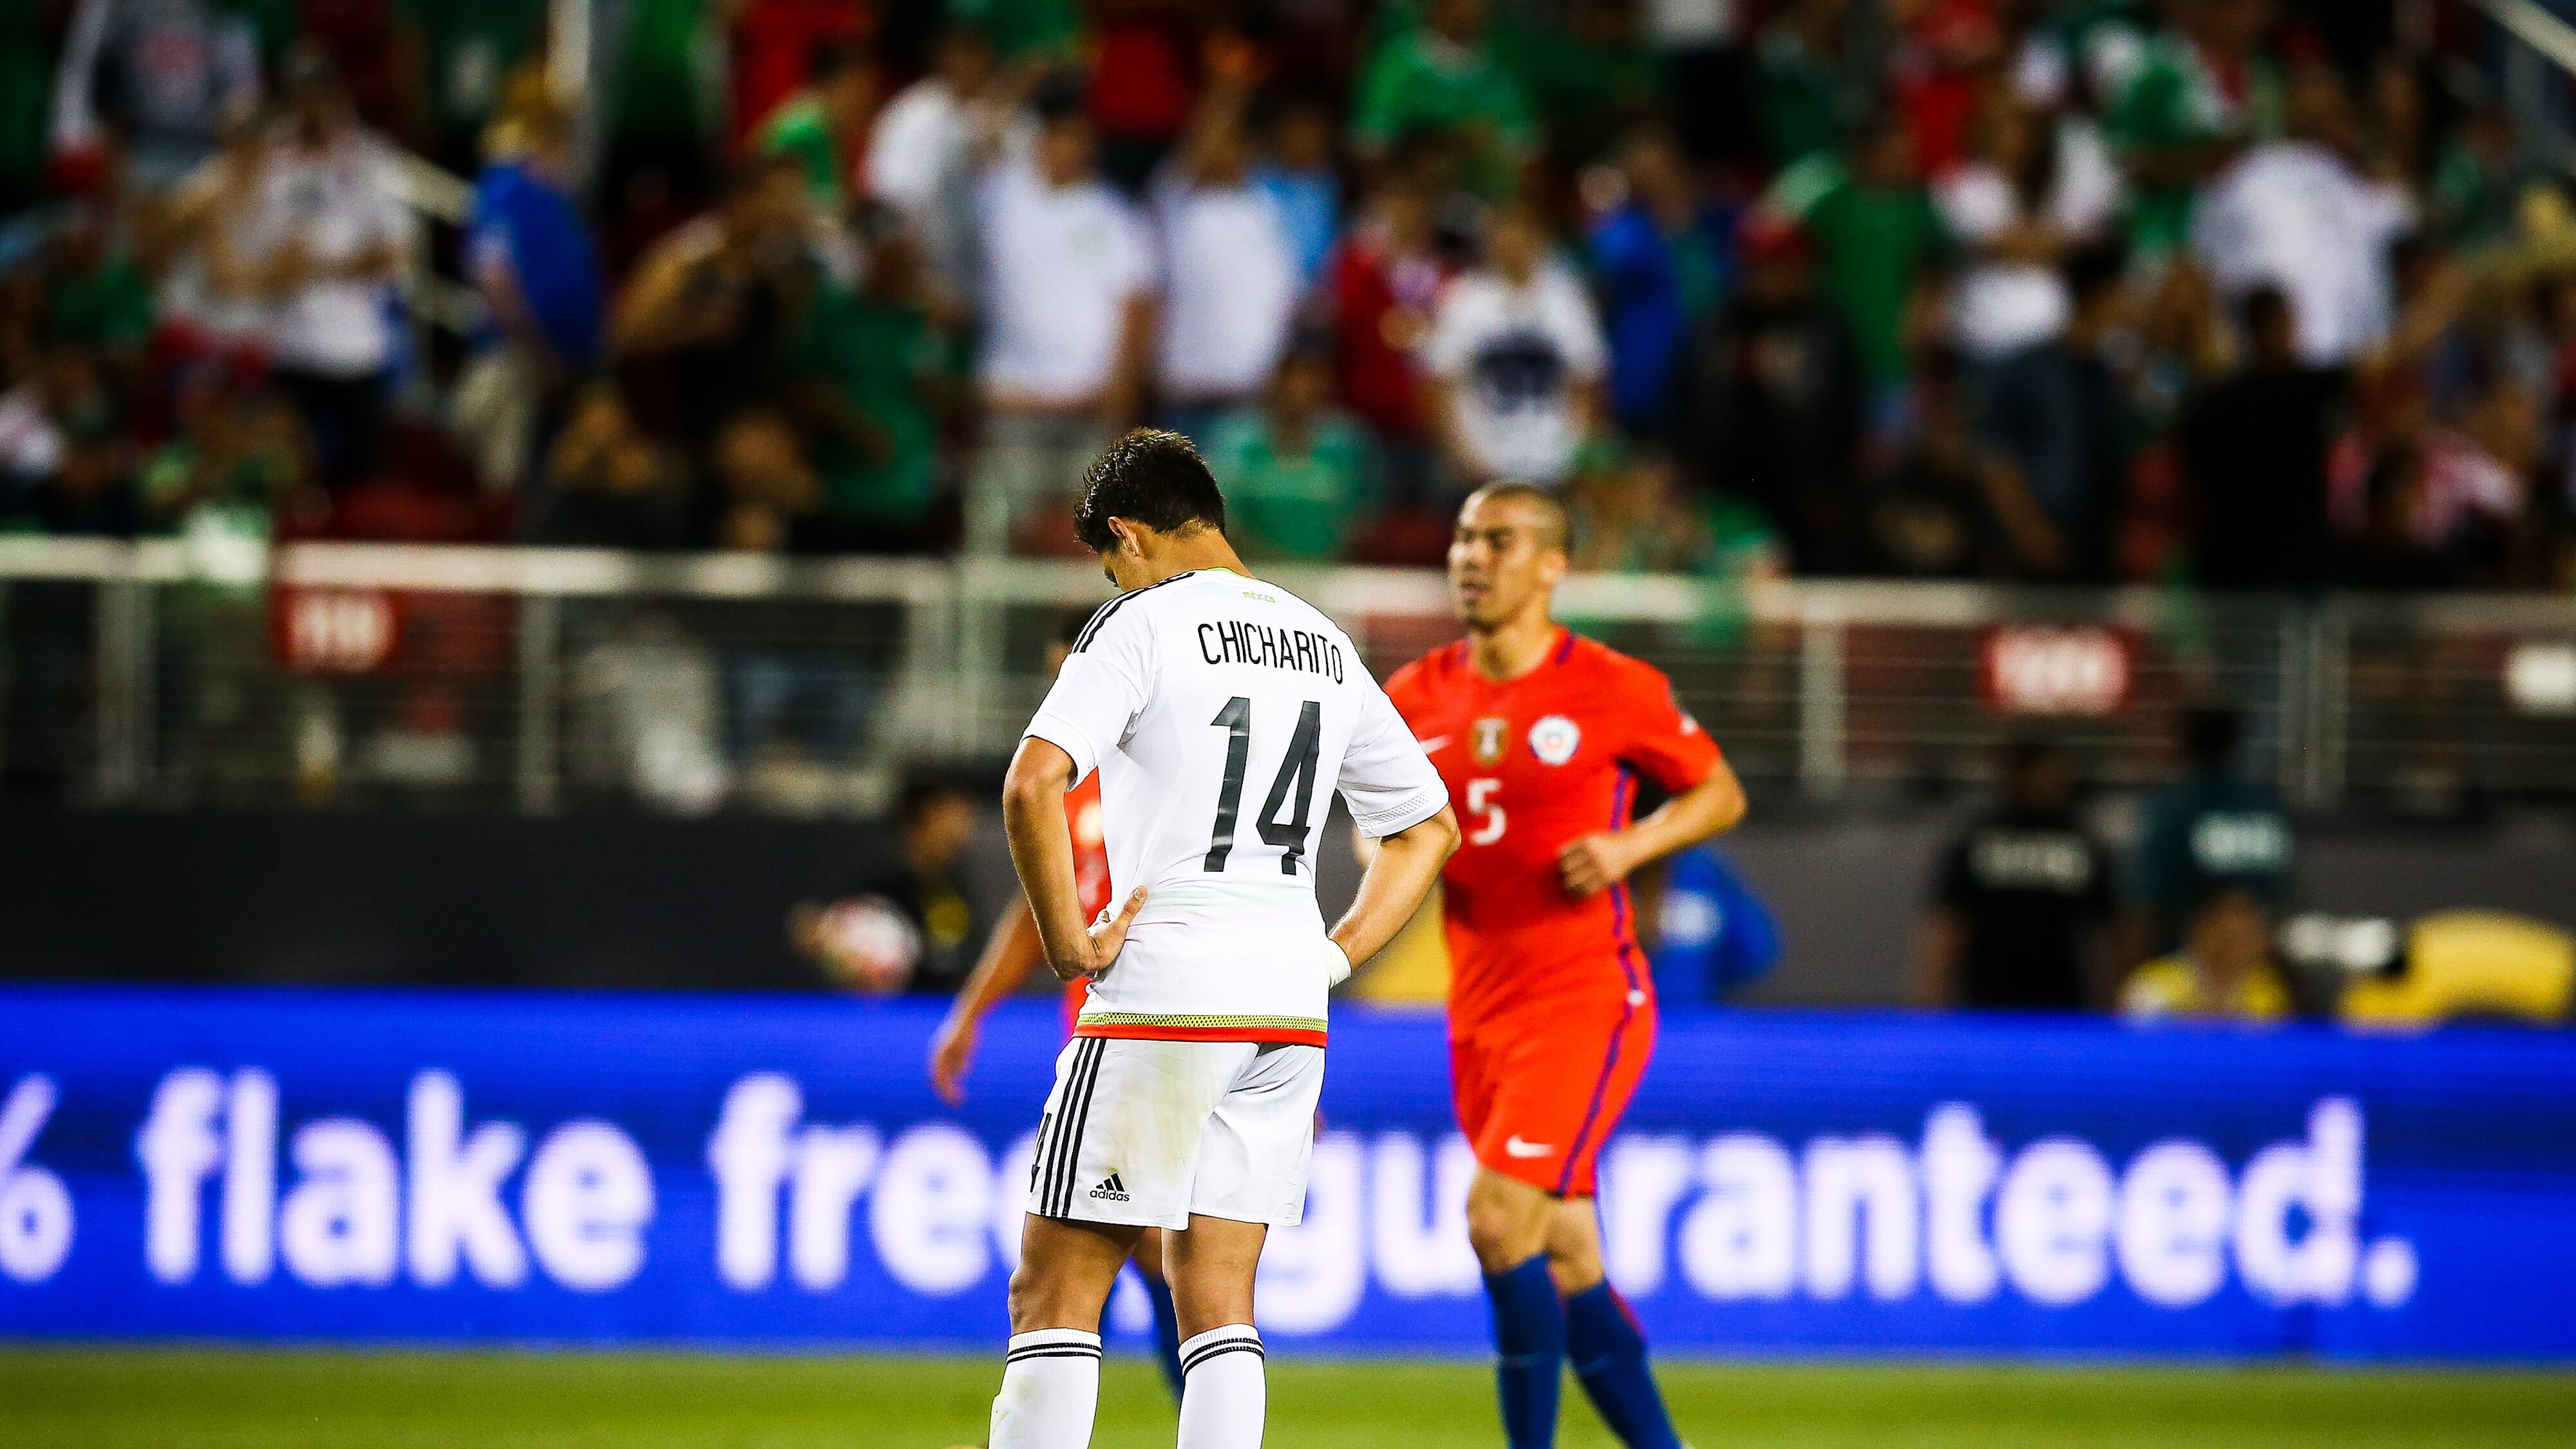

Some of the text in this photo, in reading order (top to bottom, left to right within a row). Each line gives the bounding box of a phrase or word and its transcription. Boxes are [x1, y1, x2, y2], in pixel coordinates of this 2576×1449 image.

[1197, 620, 1343, 685] CHICHARITO
[1203, 696, 1321, 875] 14
[1466, 777, 1506, 846] 5
[135, 1066, 654, 1291] flake
[1255, 1097, 2416, 1333] guranteed.
[1090, 1189, 1130, 1202] adidas
